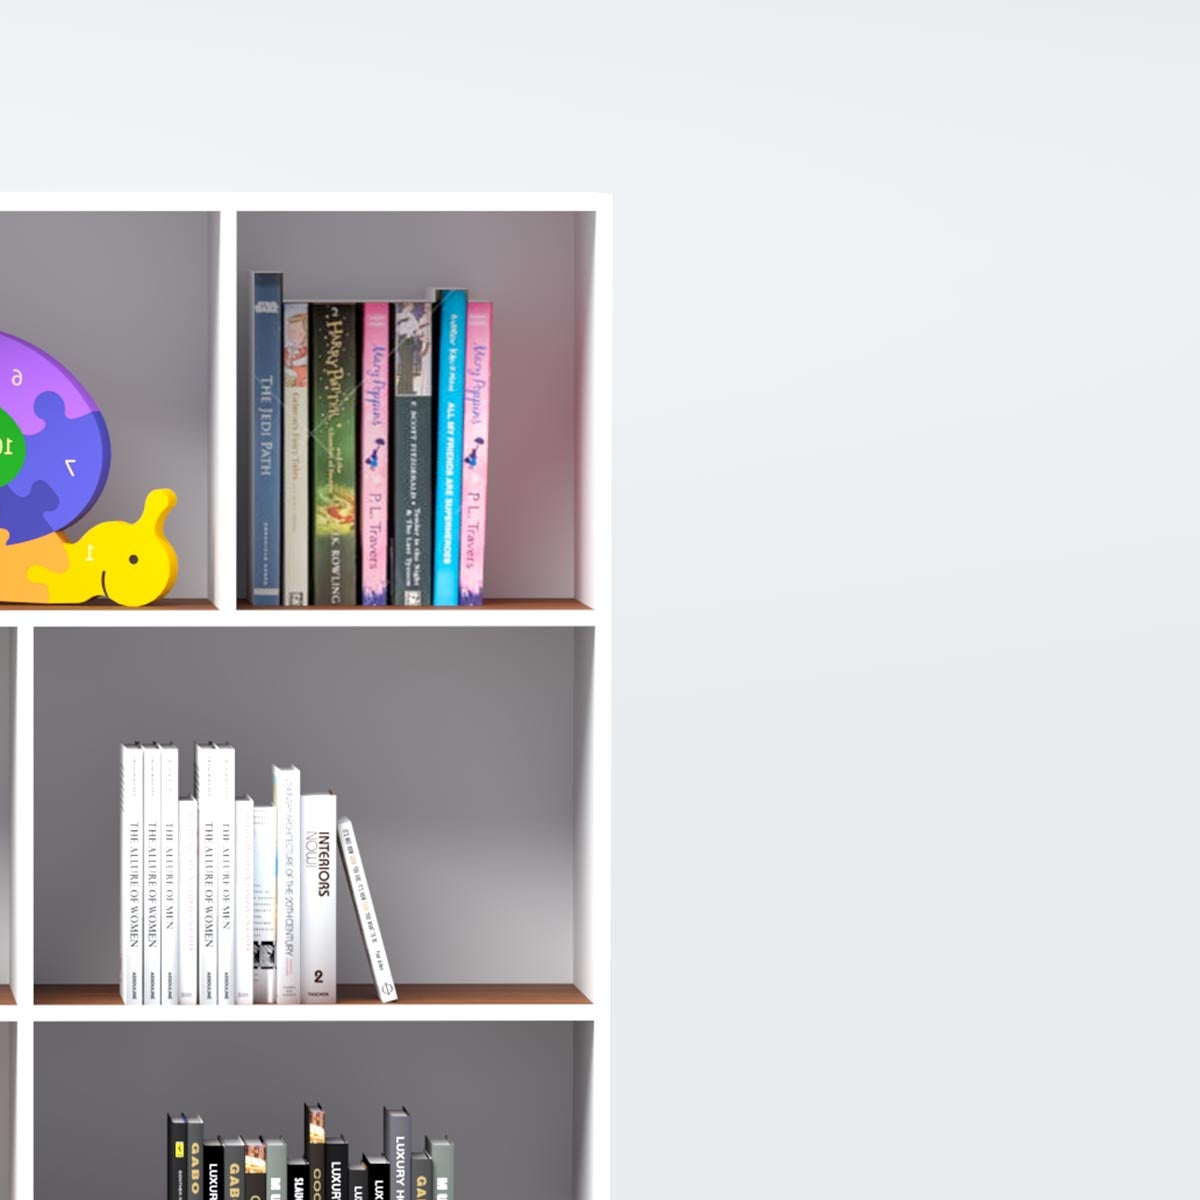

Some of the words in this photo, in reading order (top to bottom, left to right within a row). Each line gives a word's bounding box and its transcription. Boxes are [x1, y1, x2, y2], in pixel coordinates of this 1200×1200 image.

[260, 375, 273, 404] THE
[260, 407, 273, 436] JEDI
[260, 442, 273, 476] PATH
[369, 524, 382, 570] Travers
[466, 522, 480, 570] Travers
[330, 550, 341, 604] ROWLING
[129, 822, 140, 843] THE
[148, 822, 158, 843] THE
[306, 831, 318, 868] NOW!
[318, 832, 330, 898] INTERIORS
[129, 890, 140, 904] OF
[148, 890, 158, 904] OF
[129, 906, 140, 948] WOMEN
[148, 906, 158, 948] WOMEN
[204, 906, 214, 948] WOMEN
[285, 918, 294, 956] CENTURY
[314, 970, 324, 983] 2
[191, 1142, 200, 1194] GABO
[396, 1136, 405, 1186] LUXURY
